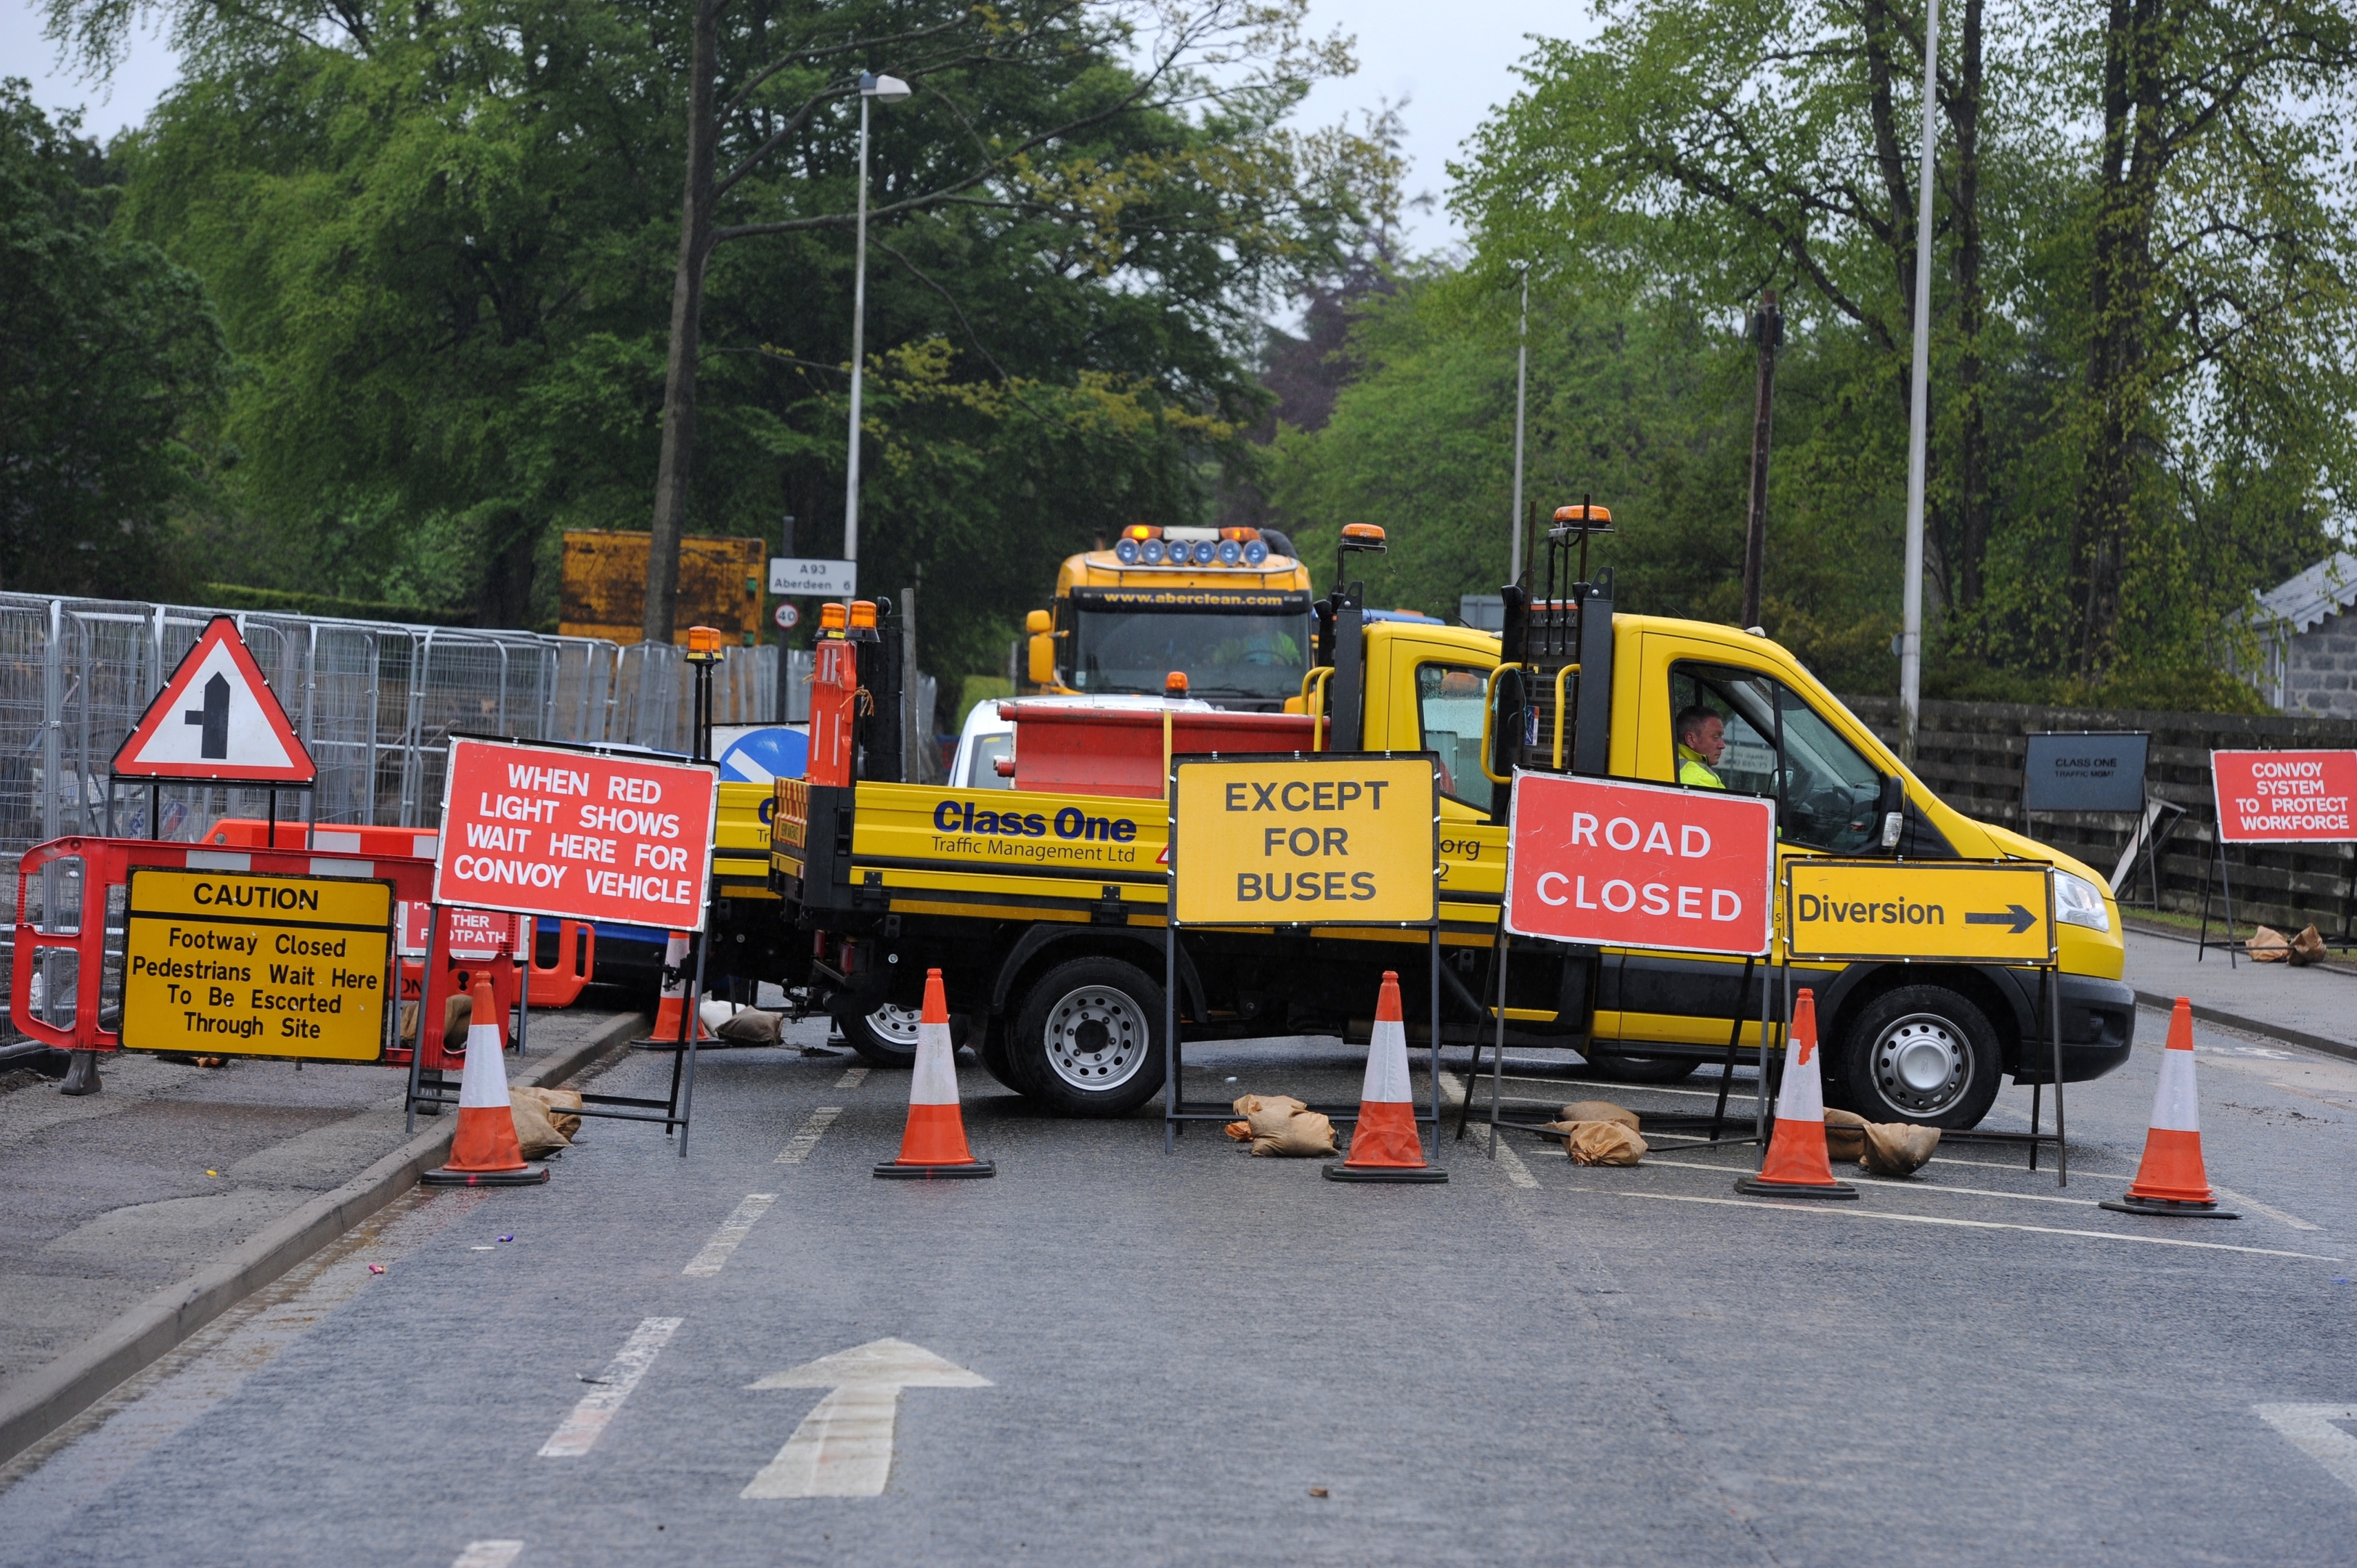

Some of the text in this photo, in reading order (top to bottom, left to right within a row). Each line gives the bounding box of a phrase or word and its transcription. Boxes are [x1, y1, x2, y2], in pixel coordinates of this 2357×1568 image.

[774, 578, 850, 591] Aberdeen 6
[1104, 592, 1283, 605] www.aberclean.com
[778, 611, 796, 621] 40
[2055, 758, 2117, 767] CLASS ONE
[2252, 762, 2322, 777] CONVOY
[508, 764, 661, 804] WHEN RED
[1226, 781, 1388, 812] EXCEPT
[2257, 780, 2324, 795] SYSTEM
[480, 793, 679, 838] LIGHT SHOWS
[2236, 797, 2348, 813] TO PROTECT
[932, 801, 1136, 842] Class One
[1572, 812, 1711, 857] ROAD
[2241, 814, 2349, 830] WORKFORCE
[467, 823, 688, 872] WAIT HERE FOR
[932, 836, 1134, 862] Traffic Management Ltd
[1265, 828, 1348, 857] FOR
[455, 855, 691, 905] CONVOY VEHICLE
[1238, 872, 1376, 902] BUSES
[194, 883, 318, 910] CAUTION
[1537, 872, 1741, 921] CLOSED
[1799, 894, 1944, 924] Diversion
[170, 928, 346, 957] Footway Closed
[420, 928, 507, 944] FTPATH
[133, 956, 251, 981] Pedestrians
[269, 964, 314, 986] Wait
[332, 968, 377, 989] Here
[168, 984, 341, 1013] To Be Escorted
[184, 1012, 320, 1038] Through Site
